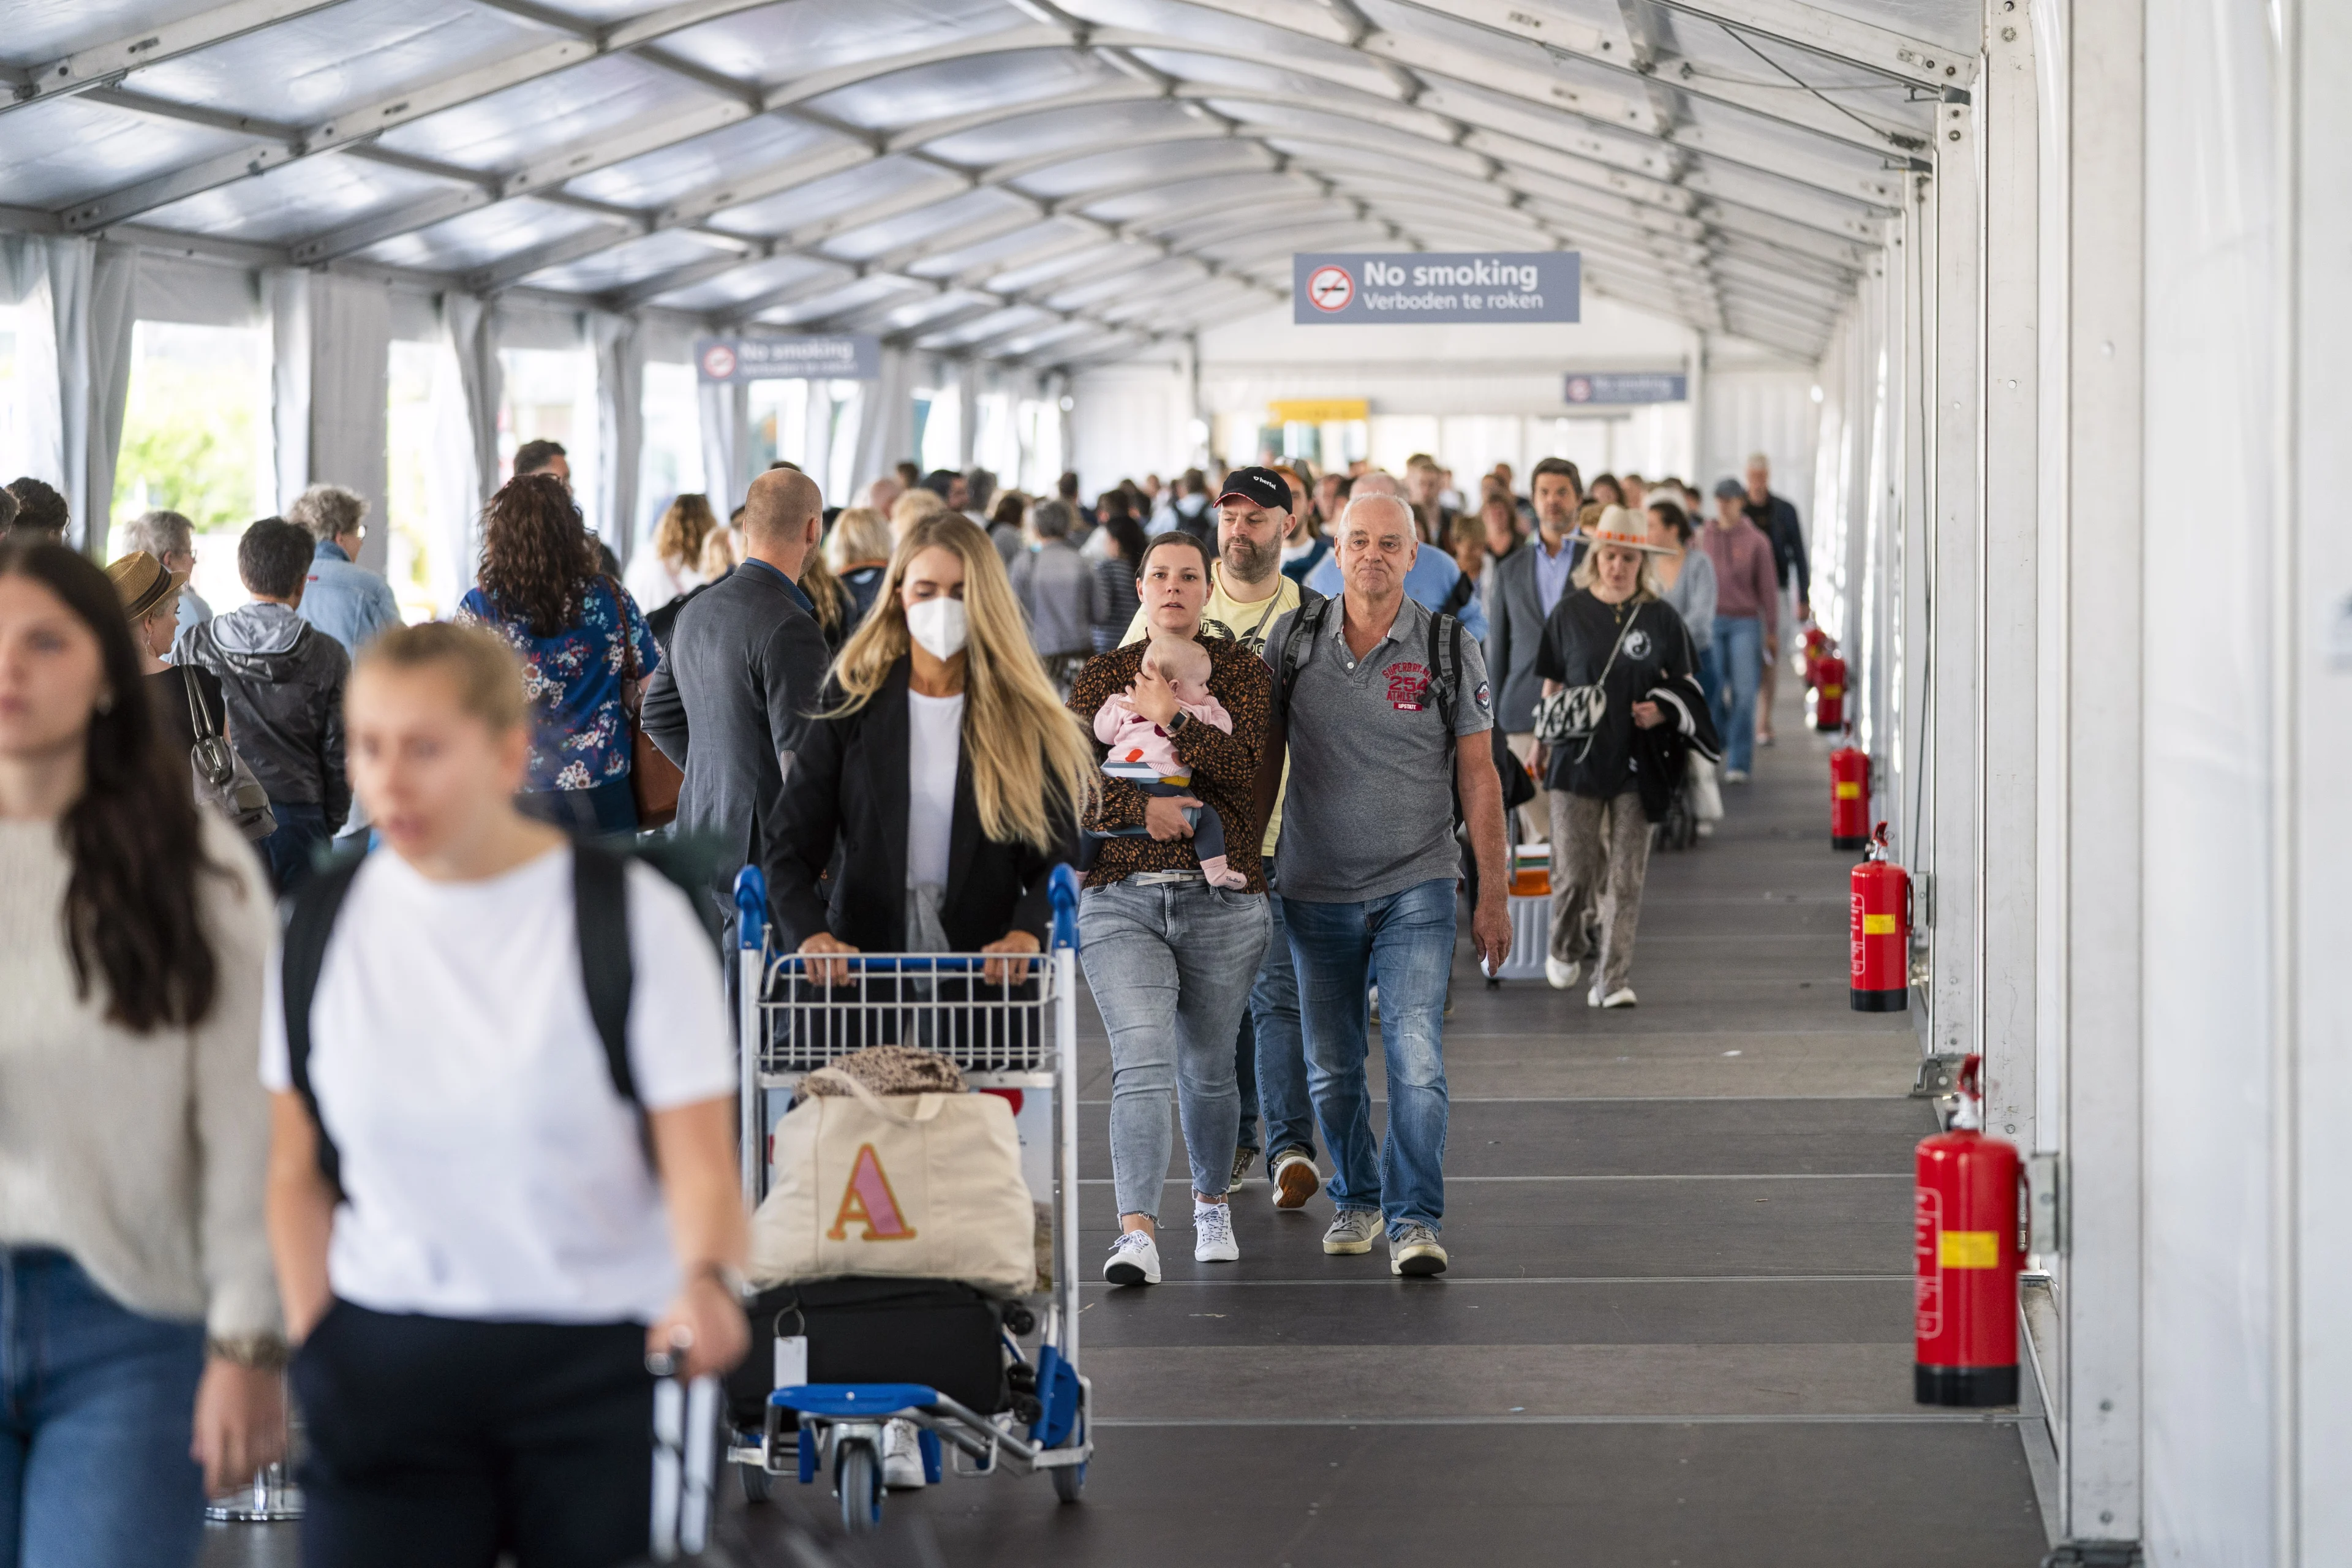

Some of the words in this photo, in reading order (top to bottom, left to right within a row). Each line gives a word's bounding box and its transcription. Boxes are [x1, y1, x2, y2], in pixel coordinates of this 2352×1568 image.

[1364, 260, 1407, 287] No
[1412, 258, 1539, 293] smoking
[1362, 290, 1458, 311] Verboden
[1461, 292, 1483, 310] te
[1487, 289, 1544, 310] roken
[739, 342, 769, 361] No
[772, 339, 854, 363] smoking
[1259, 477, 1276, 490] hertel
[1389, 676, 1428, 693] 254
[826, 1142, 917, 1241] A
